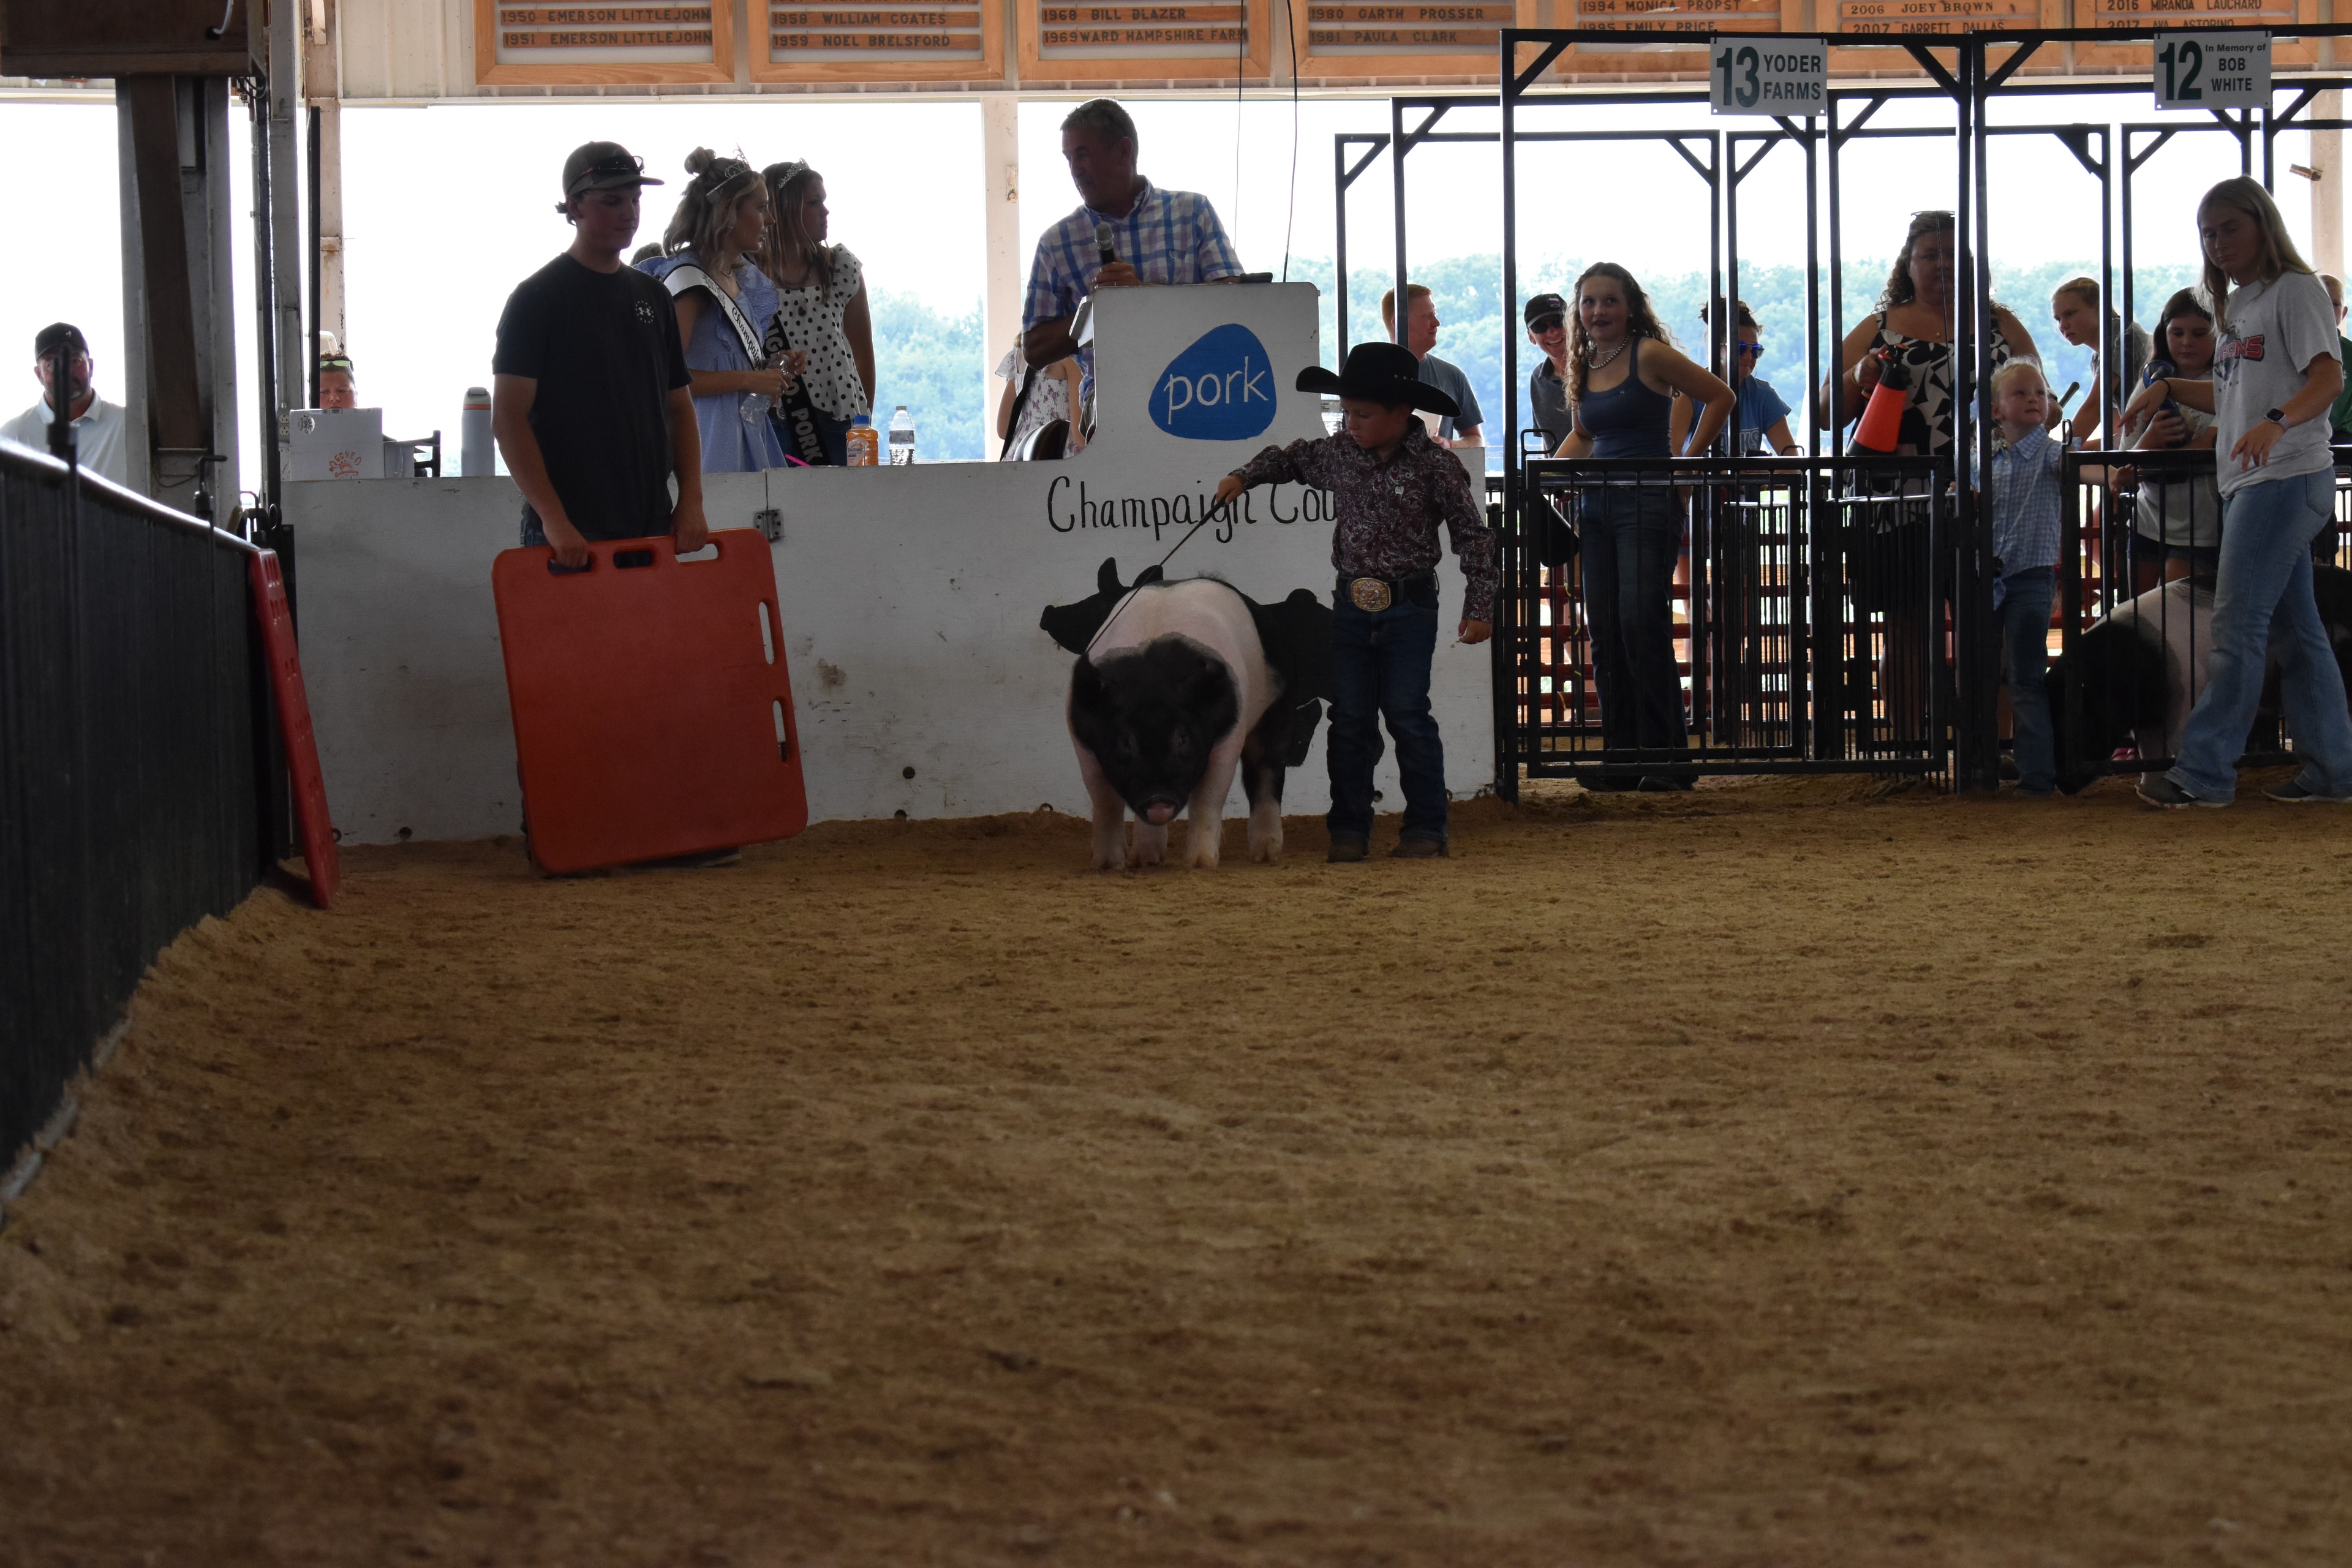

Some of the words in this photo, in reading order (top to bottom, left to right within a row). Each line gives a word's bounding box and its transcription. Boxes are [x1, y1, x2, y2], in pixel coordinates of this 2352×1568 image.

[1583, 1, 1615, 12] 1994
[1626, 1, 1677, 11] MONICA
[1687, 0, 1741, 10] PROPST
[1851, 5, 1884, 14] 2006
[1901, 4, 1937, 13] JOEY
[1943, 2, 1993, 12] BROWN
[2108, 0, 2139, 10] 2016
[2150, 0, 2195, 10] MIRANDA
[2207, 0, 2262, 9] LAUCHARD
[502, 11, 536, 22] 1950
[548, 11, 616, 21] EMERSON
[622, 9, 711, 20] LITTLEJOHN
[774, 13, 807, 24] 1958
[823, 13, 881, 24] WILLIAM
[890, 13, 947, 24] COATES
[1044, 9, 1077, 21] 1968
[1091, 9, 1121, 20] BILL
[1132, 8, 1186, 20] BLAZER
[1359, 9, 1404, 19] GARTH
[1420, 9, 1483, 19] PROSSER
[1676, 21, 1716, 31] PRICE
[1902, 23, 1950, 33] GARRETT
[505, 34, 535, 45] 1951
[551, 33, 617, 45] EMERSON
[624, 31, 712, 43] LITTLEJOHN
[774, 36, 809, 47] 1959
[823, 36, 859, 47] NOEL
[869, 36, 951, 47] BRELSFORD
[1045, 32, 1078, 43] 1969
[1080, 31, 1120, 42] WARD
[1126, 30, 1204, 42] HAMPSHIRE
[1311, 32, 1341, 42] 1981
[1355, 32, 1399, 42] PAULA
[1413, 31, 1457, 42] CLARK
[2158, 40, 2203, 100] 12
[2217, 43, 2254, 53] Memory
[2218, 58, 2245, 71] BOB
[1716, 46, 1760, 108] 13
[1763, 55, 1821, 73] YODER
[1763, 81, 1821, 100] FARMS
[2211, 78, 2252, 91] WHITE
[1163, 356, 1270, 425] pork
[791, 407, 823, 462] PORK
[1047, 475, 1257, 544] Champaign
